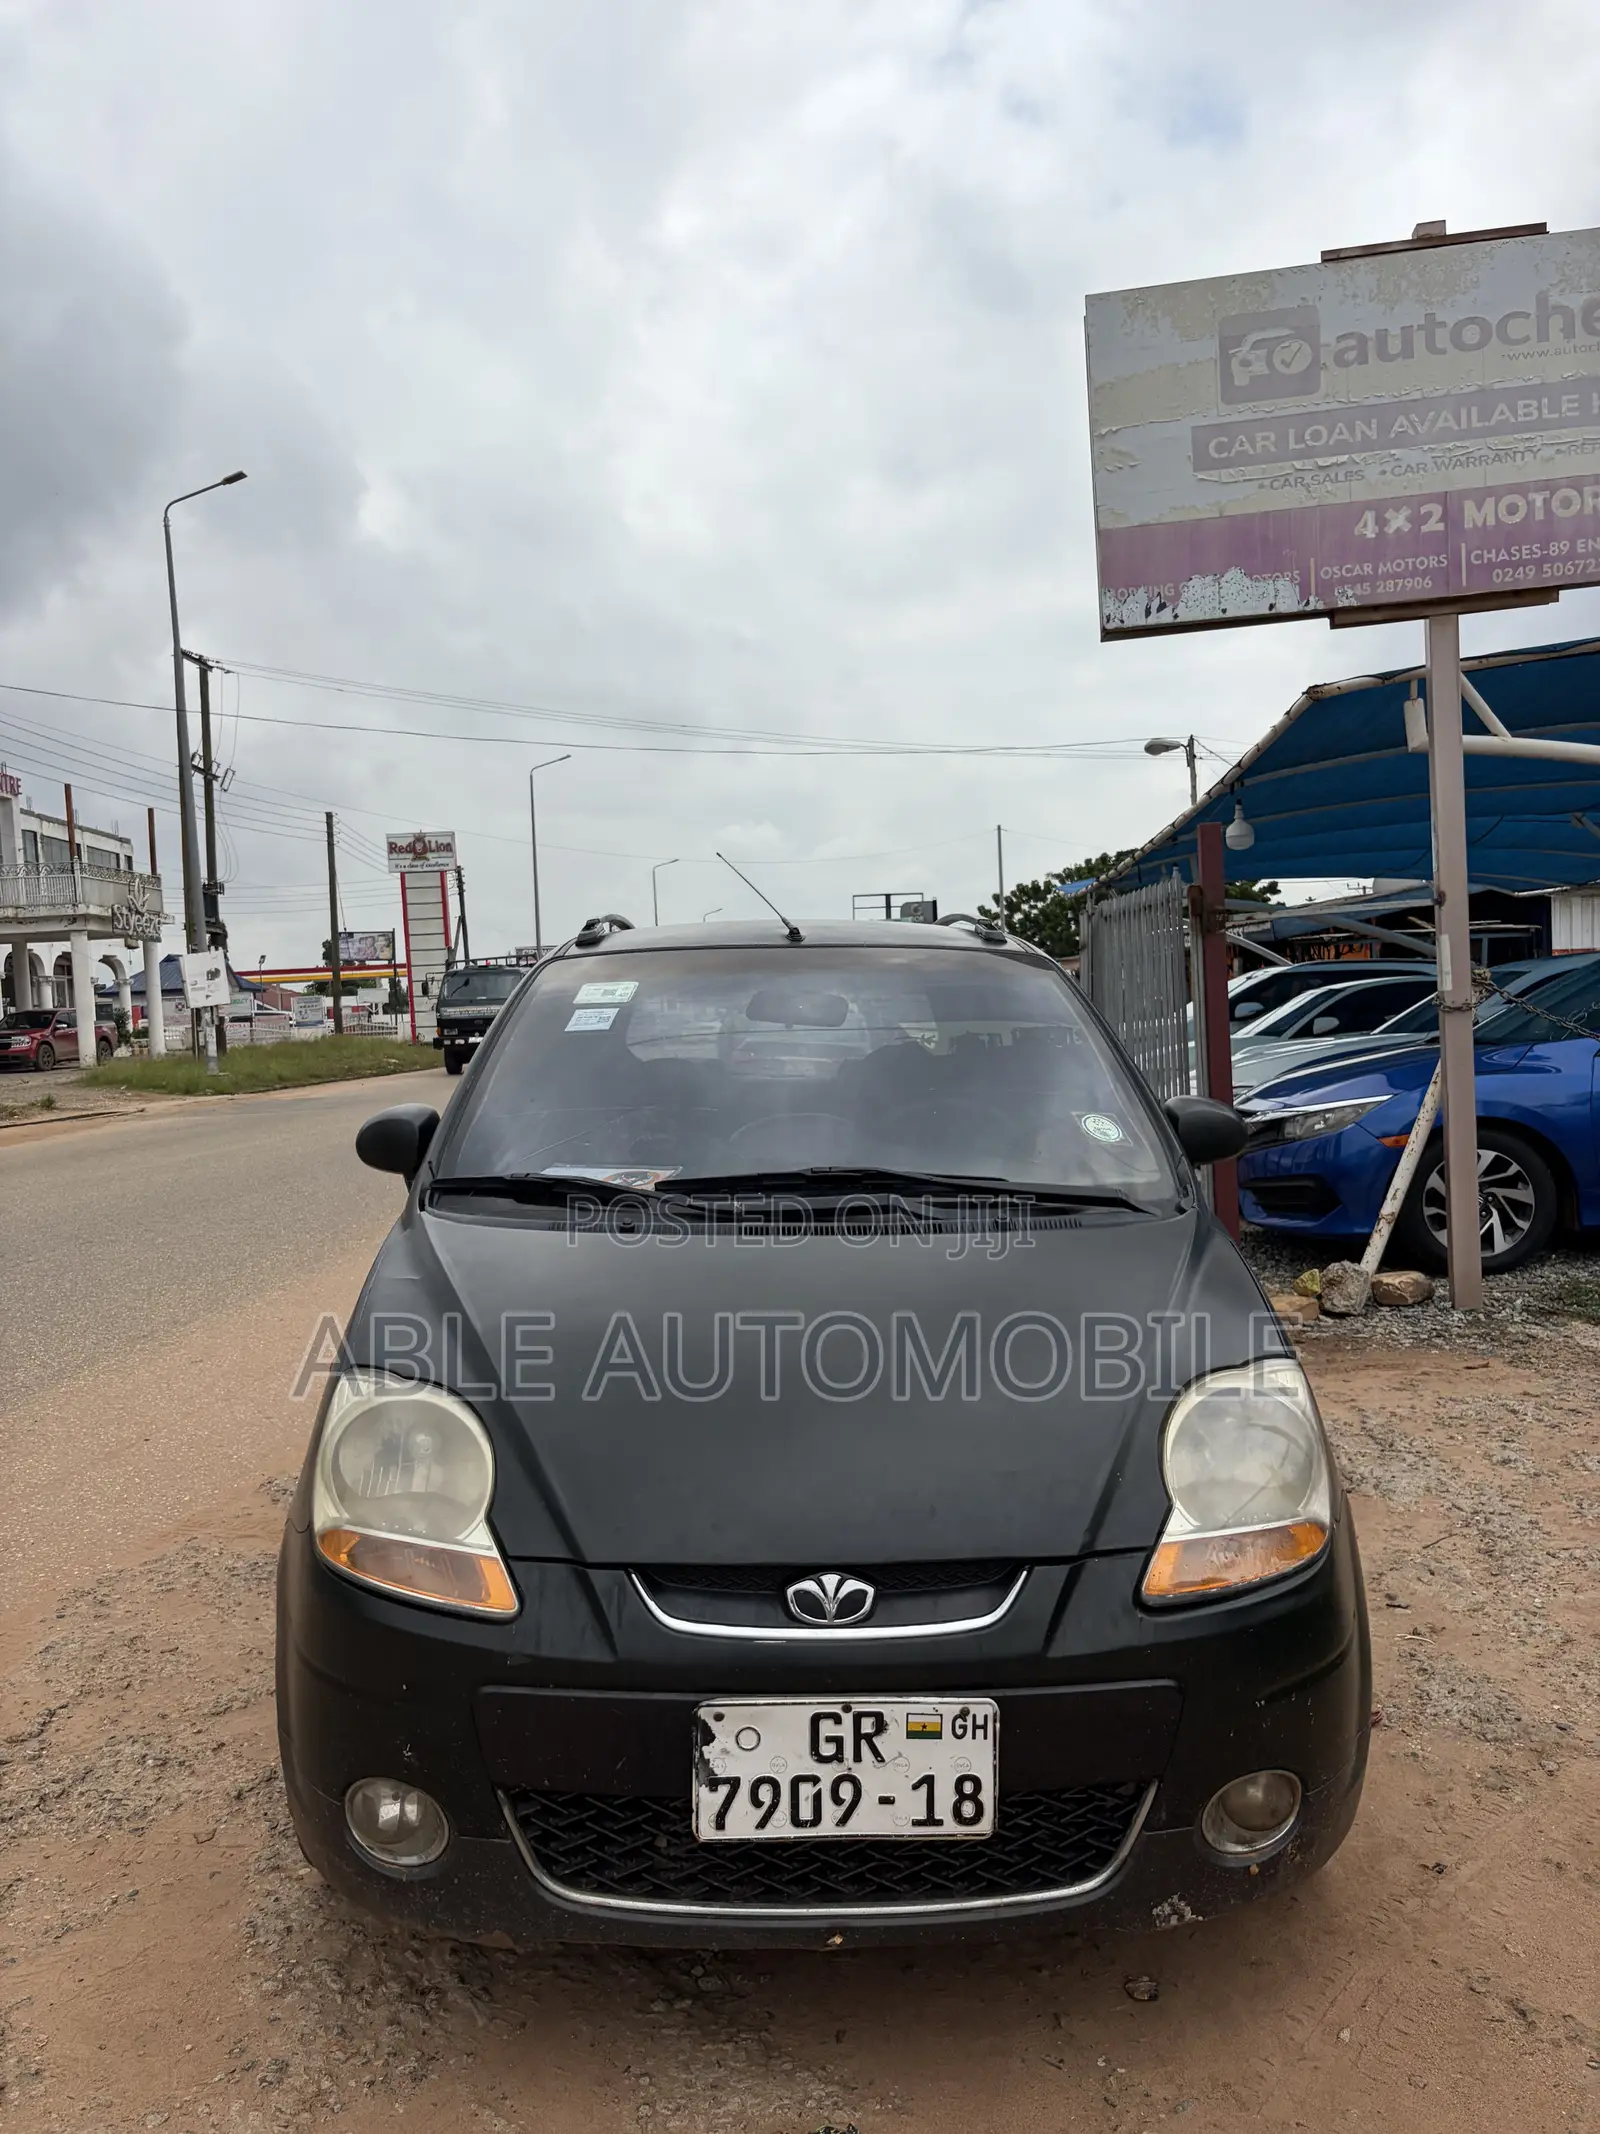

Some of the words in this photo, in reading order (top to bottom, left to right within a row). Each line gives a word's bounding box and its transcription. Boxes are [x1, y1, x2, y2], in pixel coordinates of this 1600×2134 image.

[1208, 431, 1277, 460] CAR
[1288, 418, 1378, 451] LOAN
[1389, 392, 1580, 440] AVAILABLE
[1390, 462, 1428, 478] CAR
[1434, 447, 1542, 472] WARRANTY
[1269, 475, 1306, 490] CAR
[1310, 469, 1366, 487] SALES
[1470, 540, 1570, 565] CHASES-89
[1320, 562, 1374, 580] OSCAR
[1378, 554, 1448, 575] MOTORS
[1492, 565, 1536, 583] 0249
[1541, 558, 1600, 578] 50672
[1375, 576, 1432, 595] 287906
[388, 841, 413, 854] Red
[428, 840, 453, 853] Lion
[810, 1710, 885, 1763] GR
[951, 1713, 988, 1741] GH
[708, 1773, 985, 1831] 7909-18
